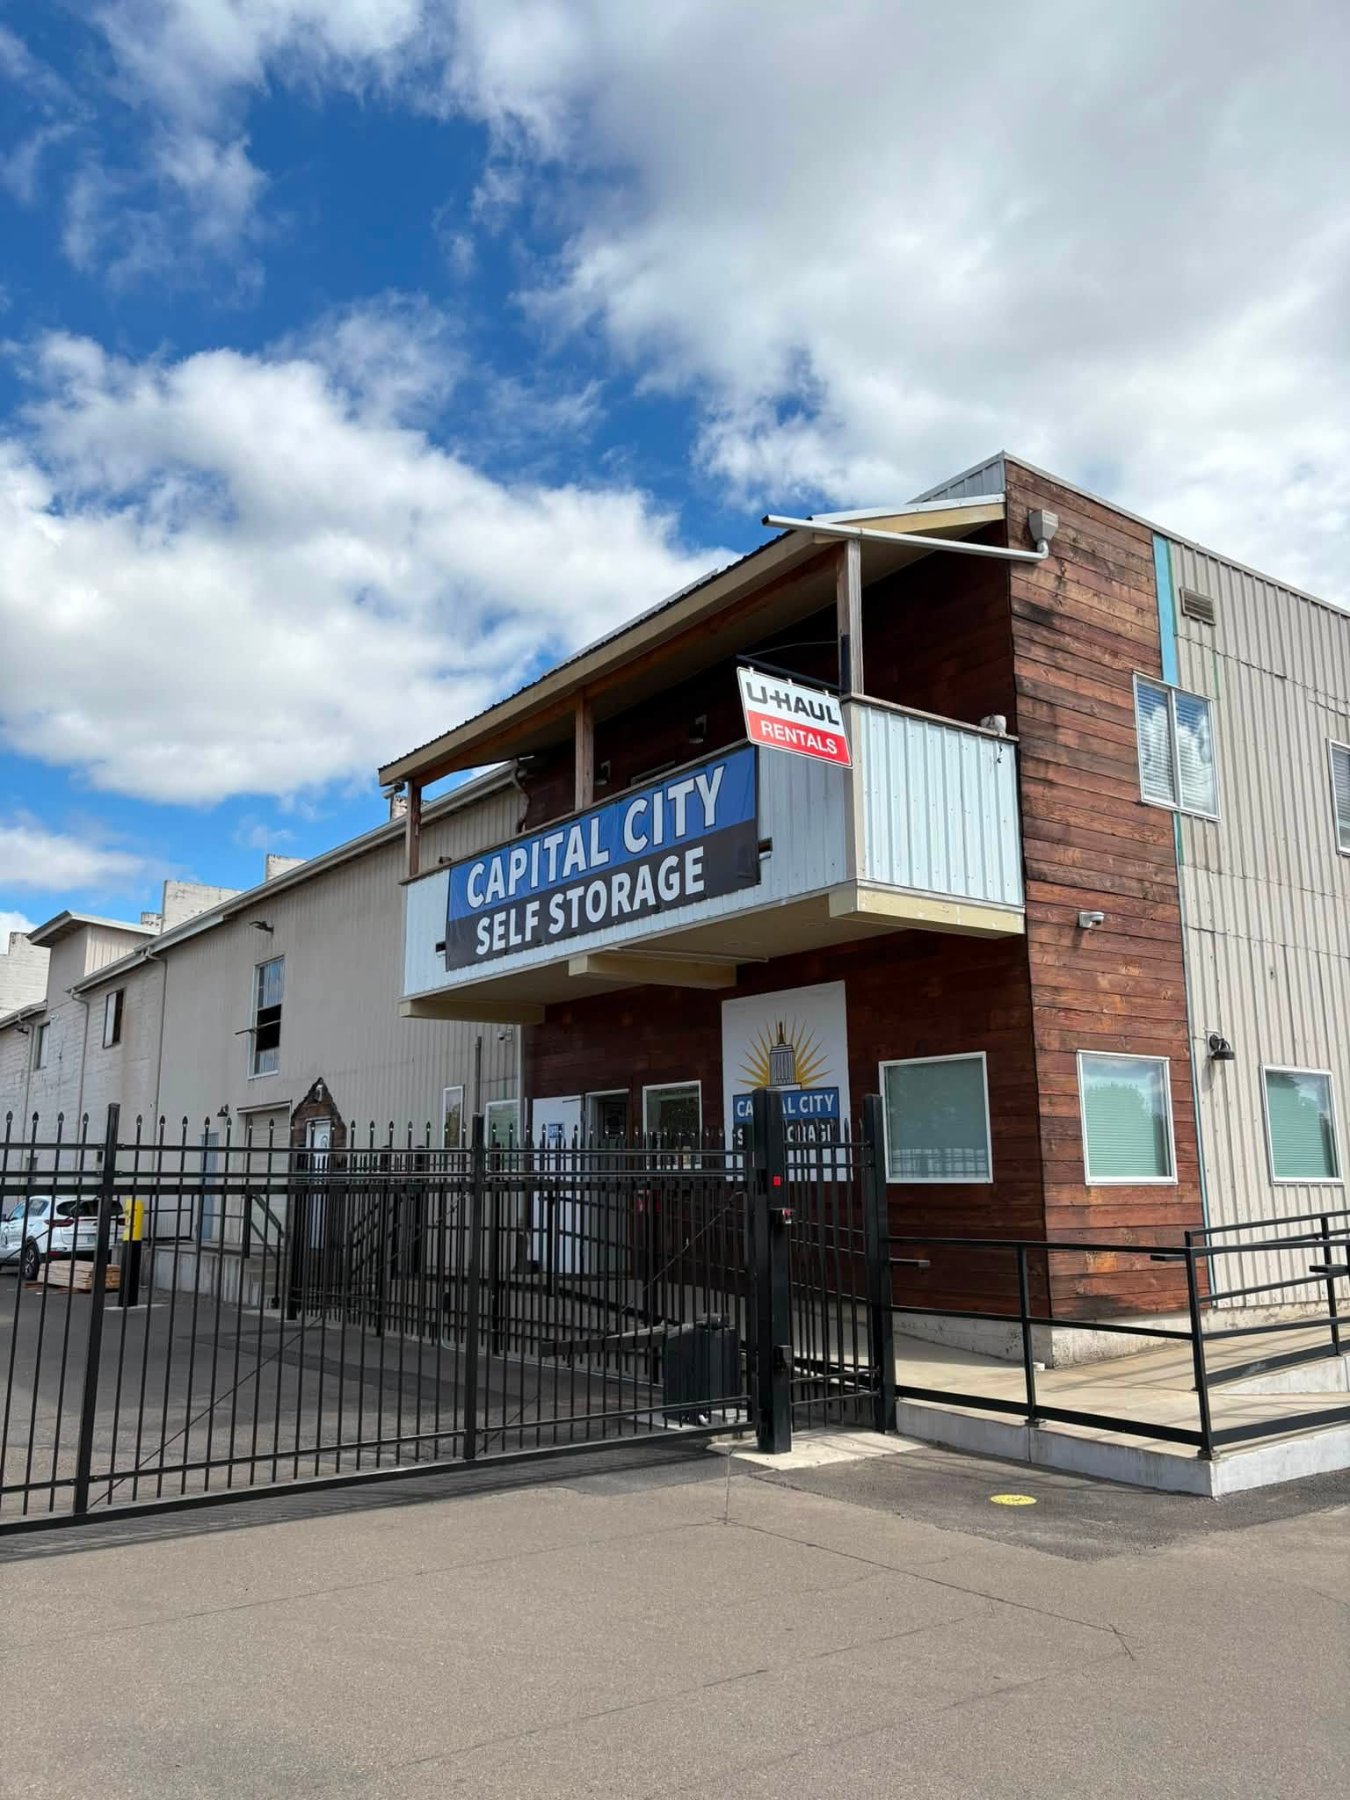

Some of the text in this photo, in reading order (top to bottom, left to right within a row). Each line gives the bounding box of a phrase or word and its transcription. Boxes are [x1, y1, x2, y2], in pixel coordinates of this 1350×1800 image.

[746, 682, 840, 726] U-HAUL
[760, 720, 838, 755] RENTALS
[466, 765, 726, 908] CAPITAL CITY
[475, 846, 705, 956] SELF STORAGE
[799, 1094, 835, 1113] CITY
